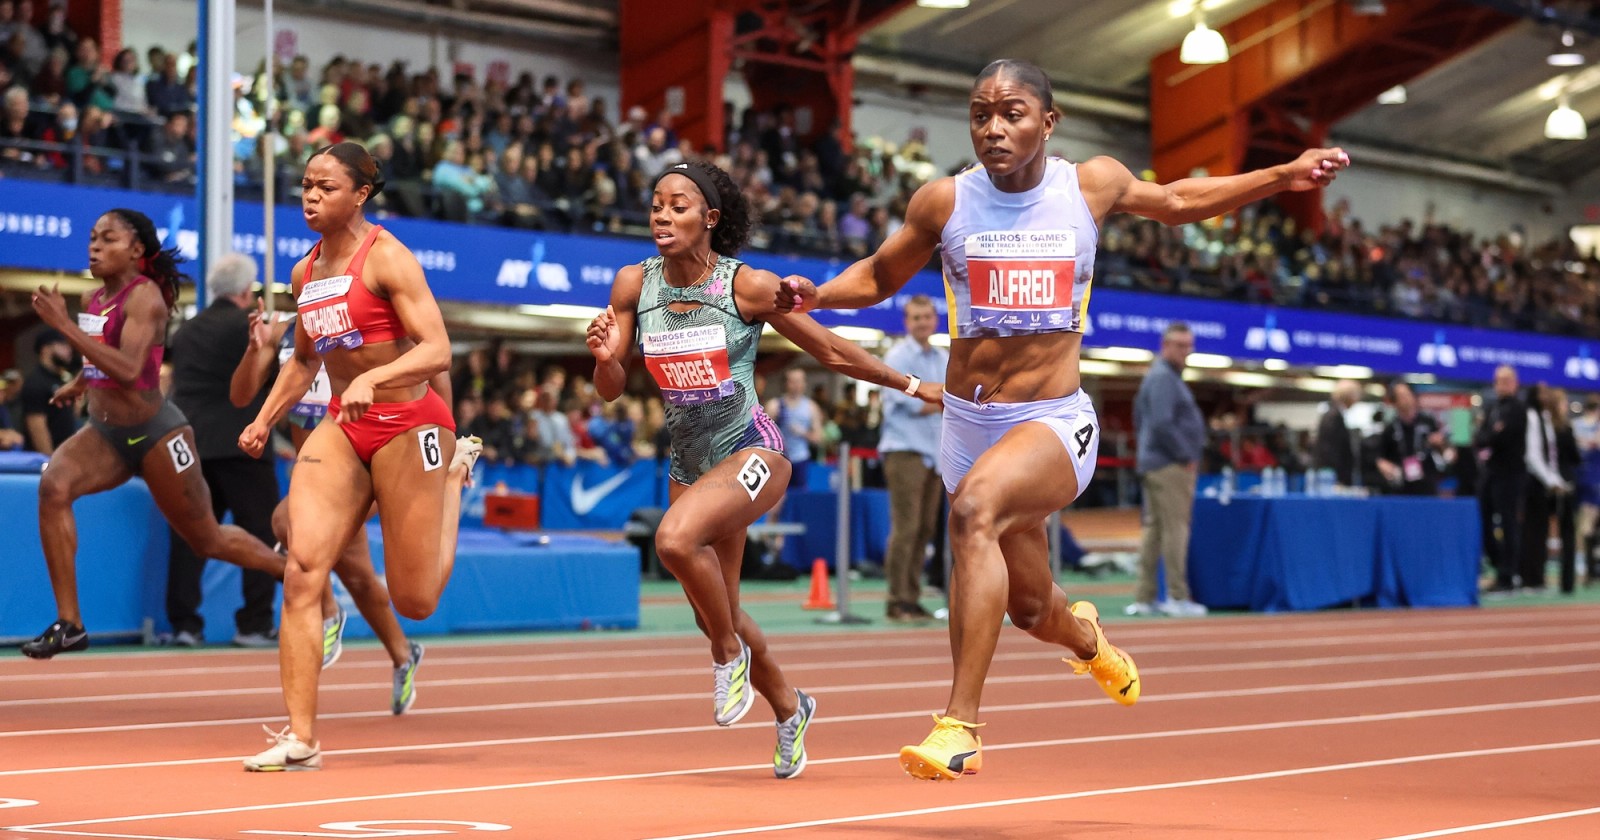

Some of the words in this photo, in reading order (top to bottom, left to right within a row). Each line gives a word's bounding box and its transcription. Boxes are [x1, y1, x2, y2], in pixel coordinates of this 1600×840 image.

[976, 234, 1027, 242] MILLROSE
[1029, 234, 1068, 242] GAMES
[988, 269, 1055, 306] ALFRED
[686, 327, 718, 338] GAMES
[660, 358, 717, 388] FORBES
[173, 439, 190, 466] 8
[424, 432, 439, 466] 6
[1074, 422, 1094, 460] 4
[743, 459, 768, 492] 5
